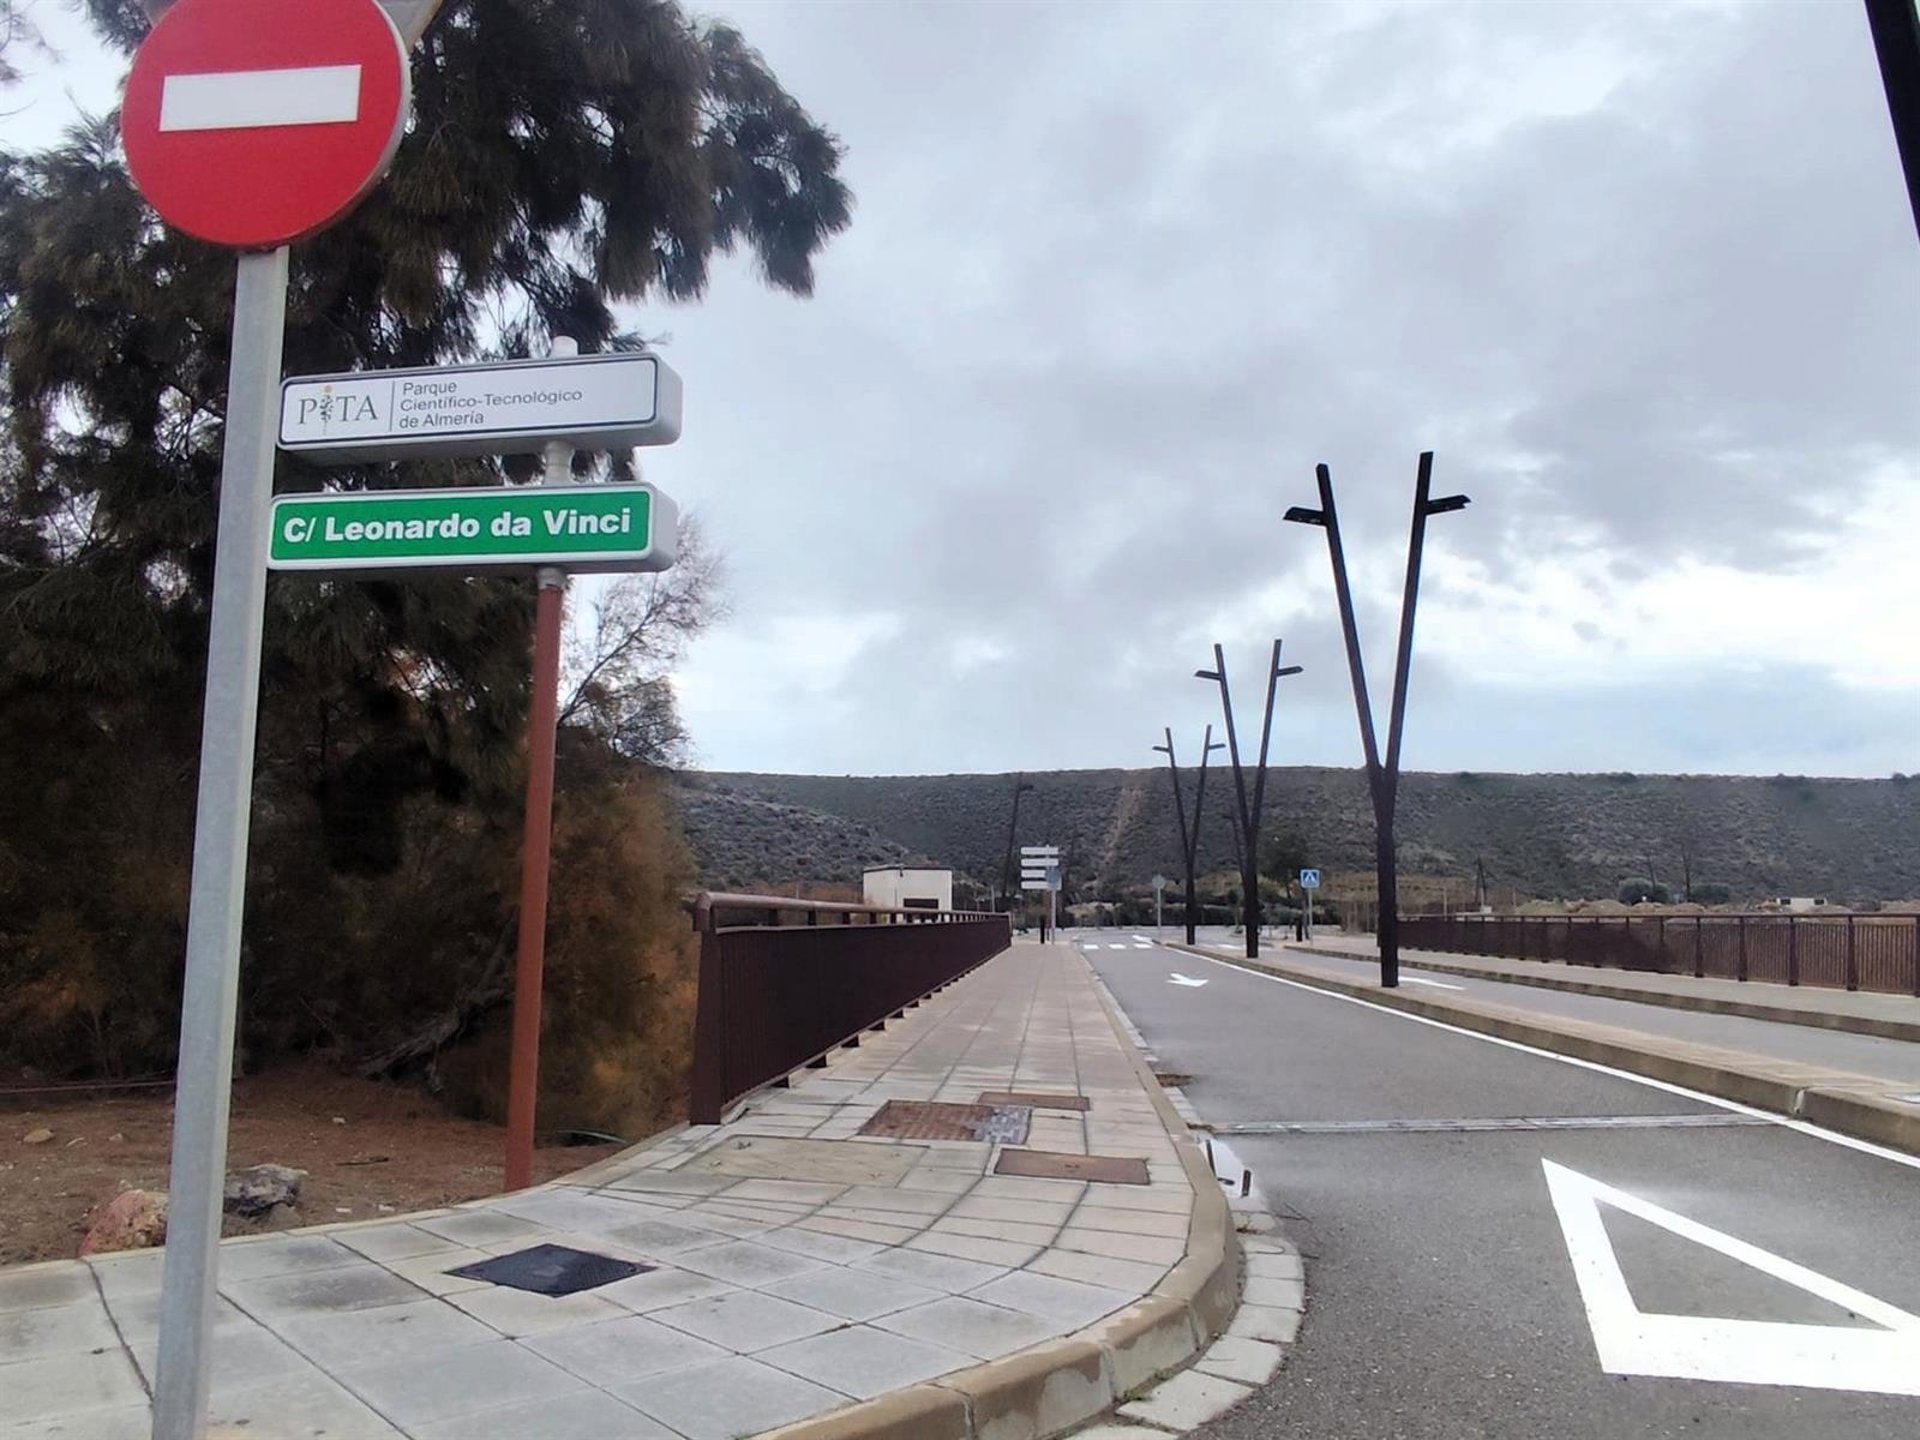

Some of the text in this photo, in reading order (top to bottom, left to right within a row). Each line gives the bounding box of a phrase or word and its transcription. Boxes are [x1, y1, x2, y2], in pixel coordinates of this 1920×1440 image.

[402, 381, 458, 397] Parque
[400, 389, 583, 412] Científico-Tecnológico
[399, 410, 485, 429] de Almería
[283, 507, 632, 543] C/ Leonardo da Vinci
